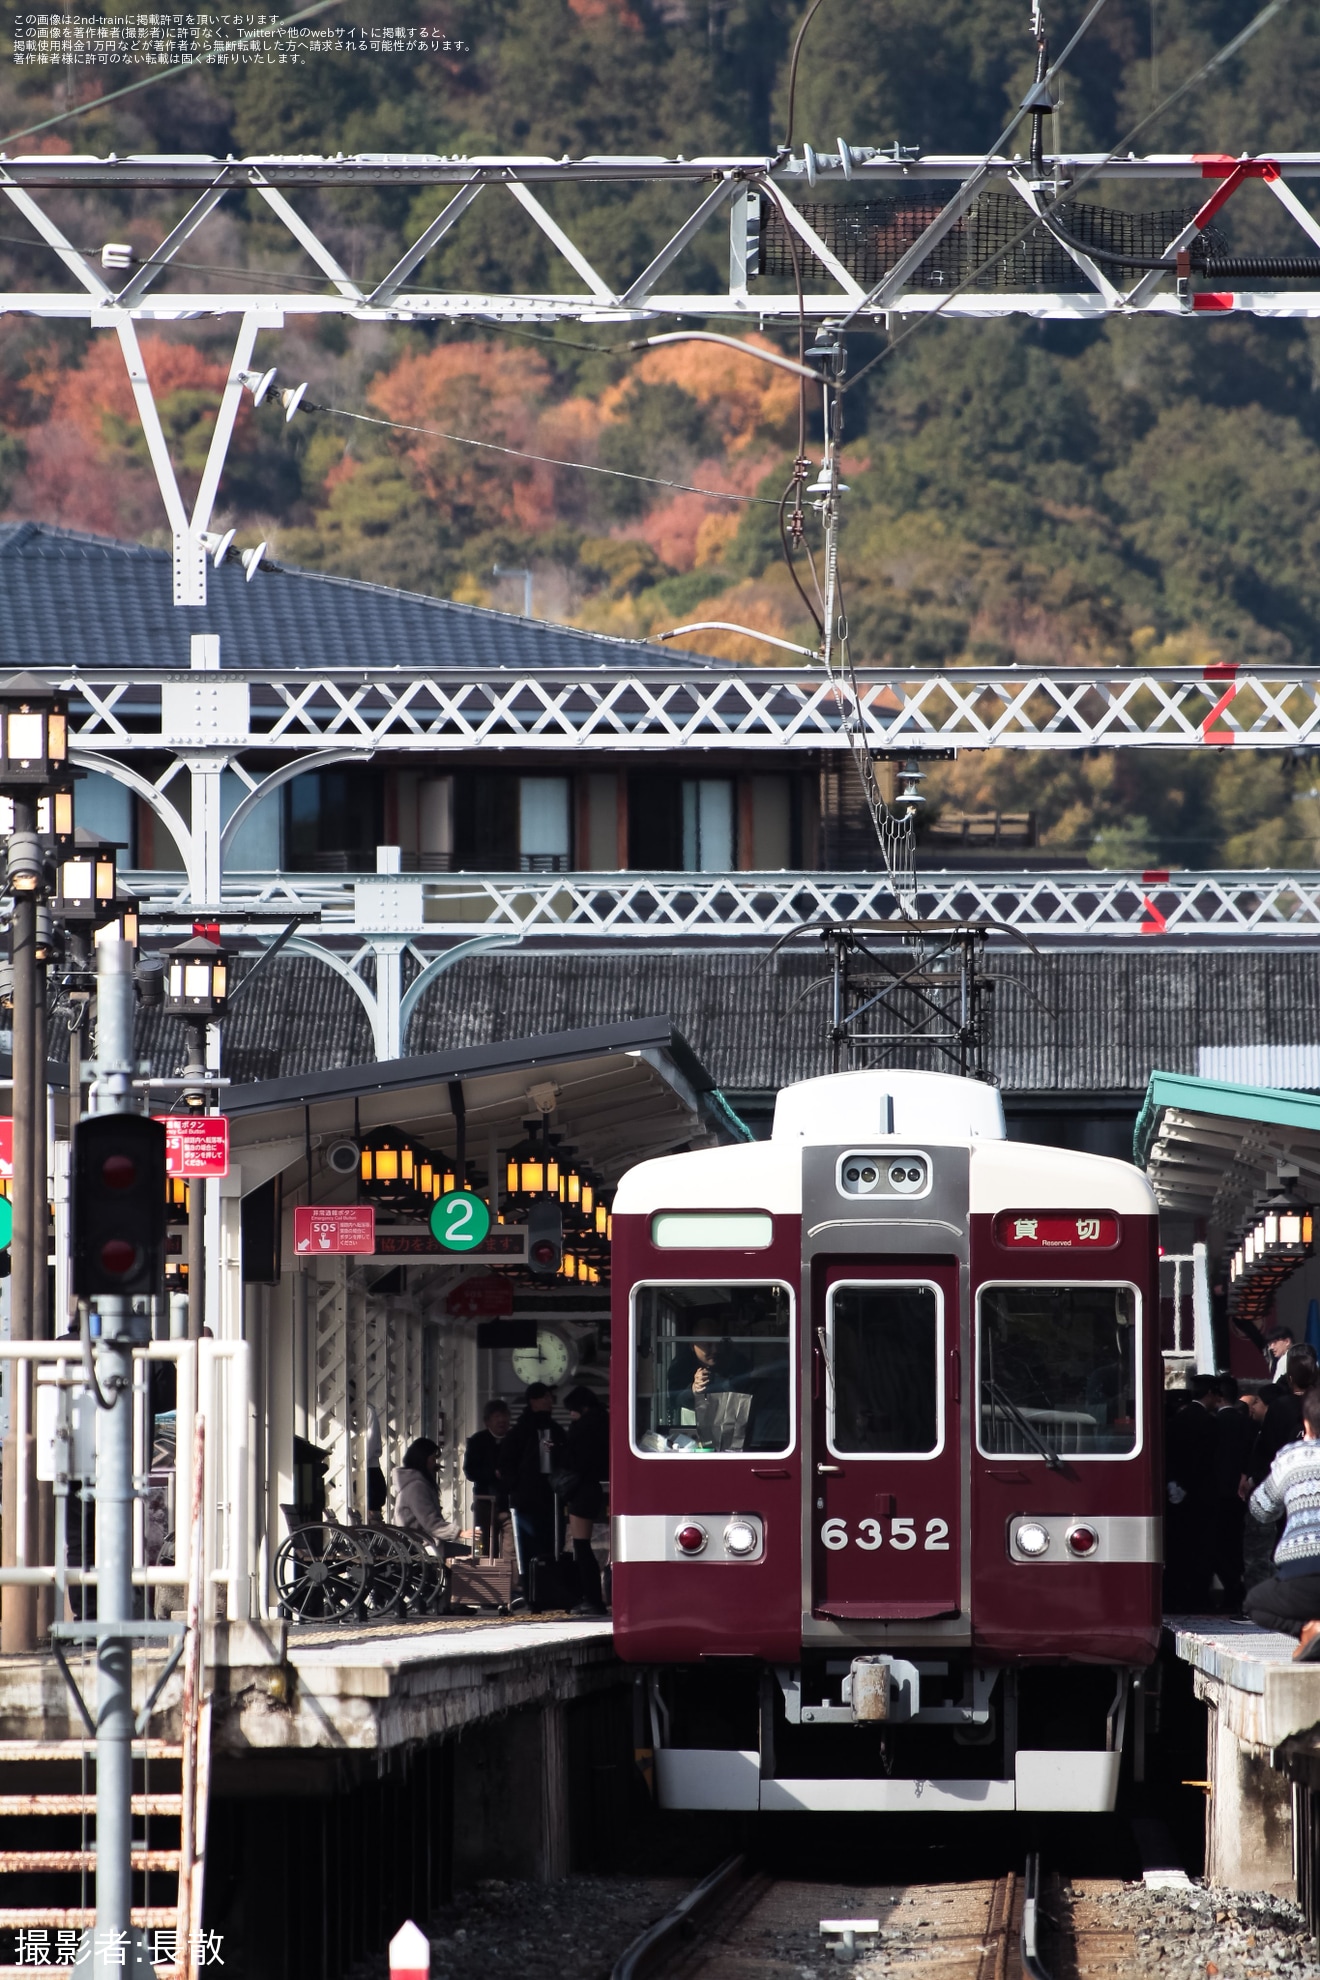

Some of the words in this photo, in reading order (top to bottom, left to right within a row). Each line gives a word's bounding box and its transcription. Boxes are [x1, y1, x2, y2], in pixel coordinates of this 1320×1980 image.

[313, 1223, 336, 1232] SOS
[445, 1199, 473, 1241] 2
[821, 1518, 949, 1550] 6352
